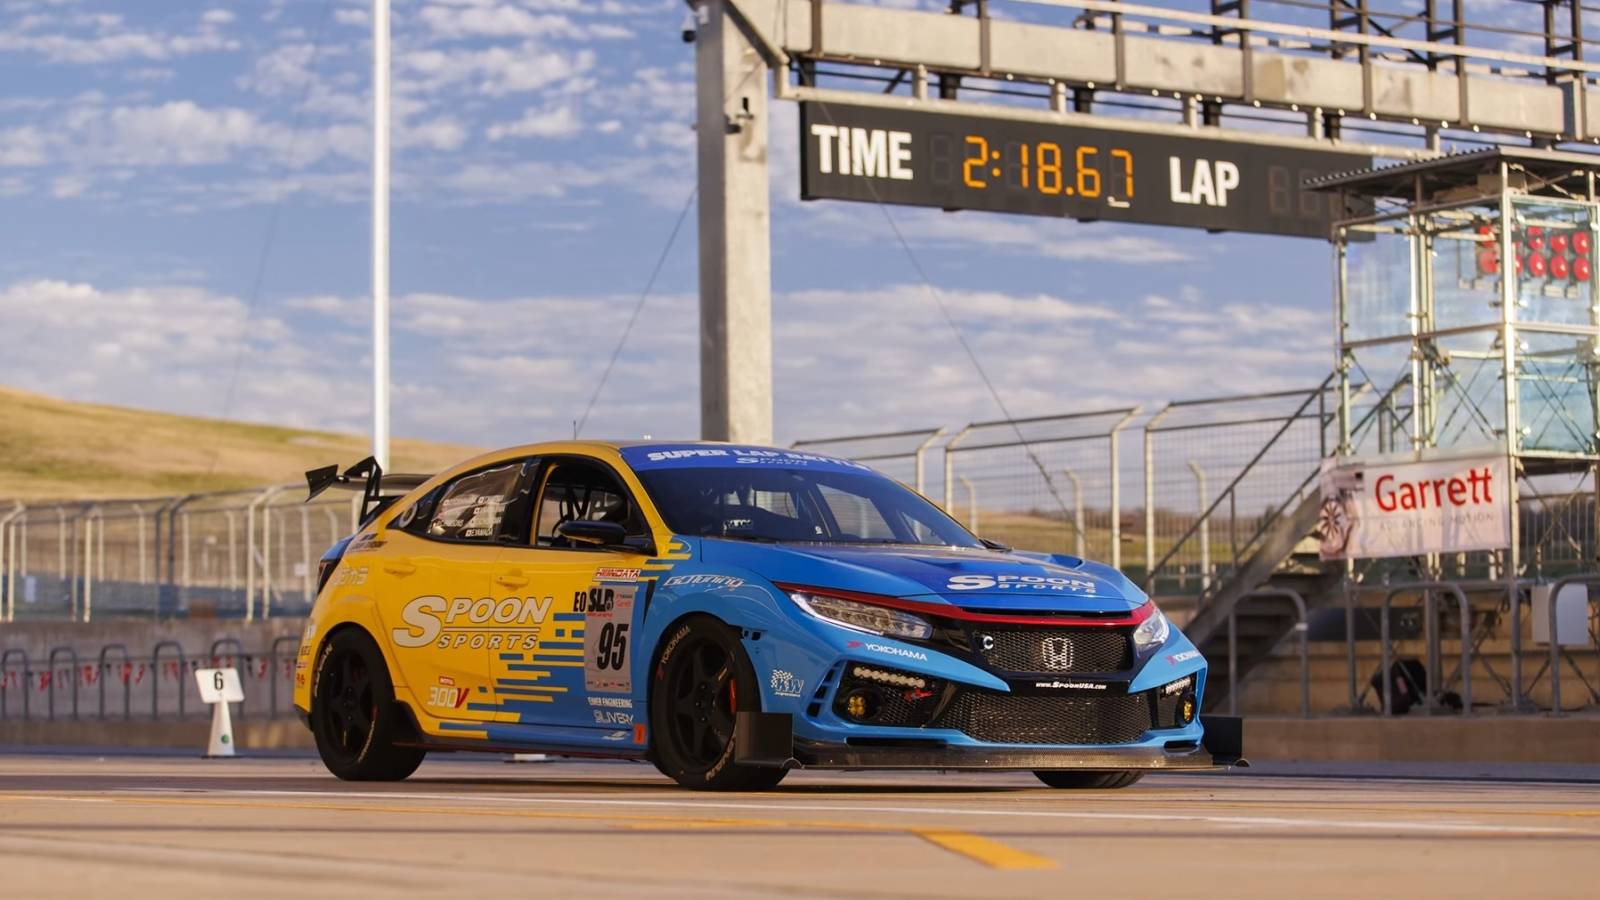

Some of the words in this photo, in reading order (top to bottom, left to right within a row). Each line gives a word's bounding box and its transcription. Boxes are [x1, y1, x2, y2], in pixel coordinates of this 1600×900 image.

[811, 124, 913, 180] TIME
[962, 135, 1134, 198] 2:18.67
[1169, 156, 1240, 207] LAP
[648, 449, 729, 461] SUPER
[1374, 467, 1493, 512] Garrett
[947, 575, 1096, 590] SPOON
[998, 584, 1097, 594] SPORTS
[392, 595, 553, 648] SPOON
[437, 633, 538, 650] SPORTS
[597, 622, 629, 671] 95
[865, 643, 928, 661] YOKOHAMA
[214, 671, 223, 691] 6
[428, 686, 471, 708] 300V
